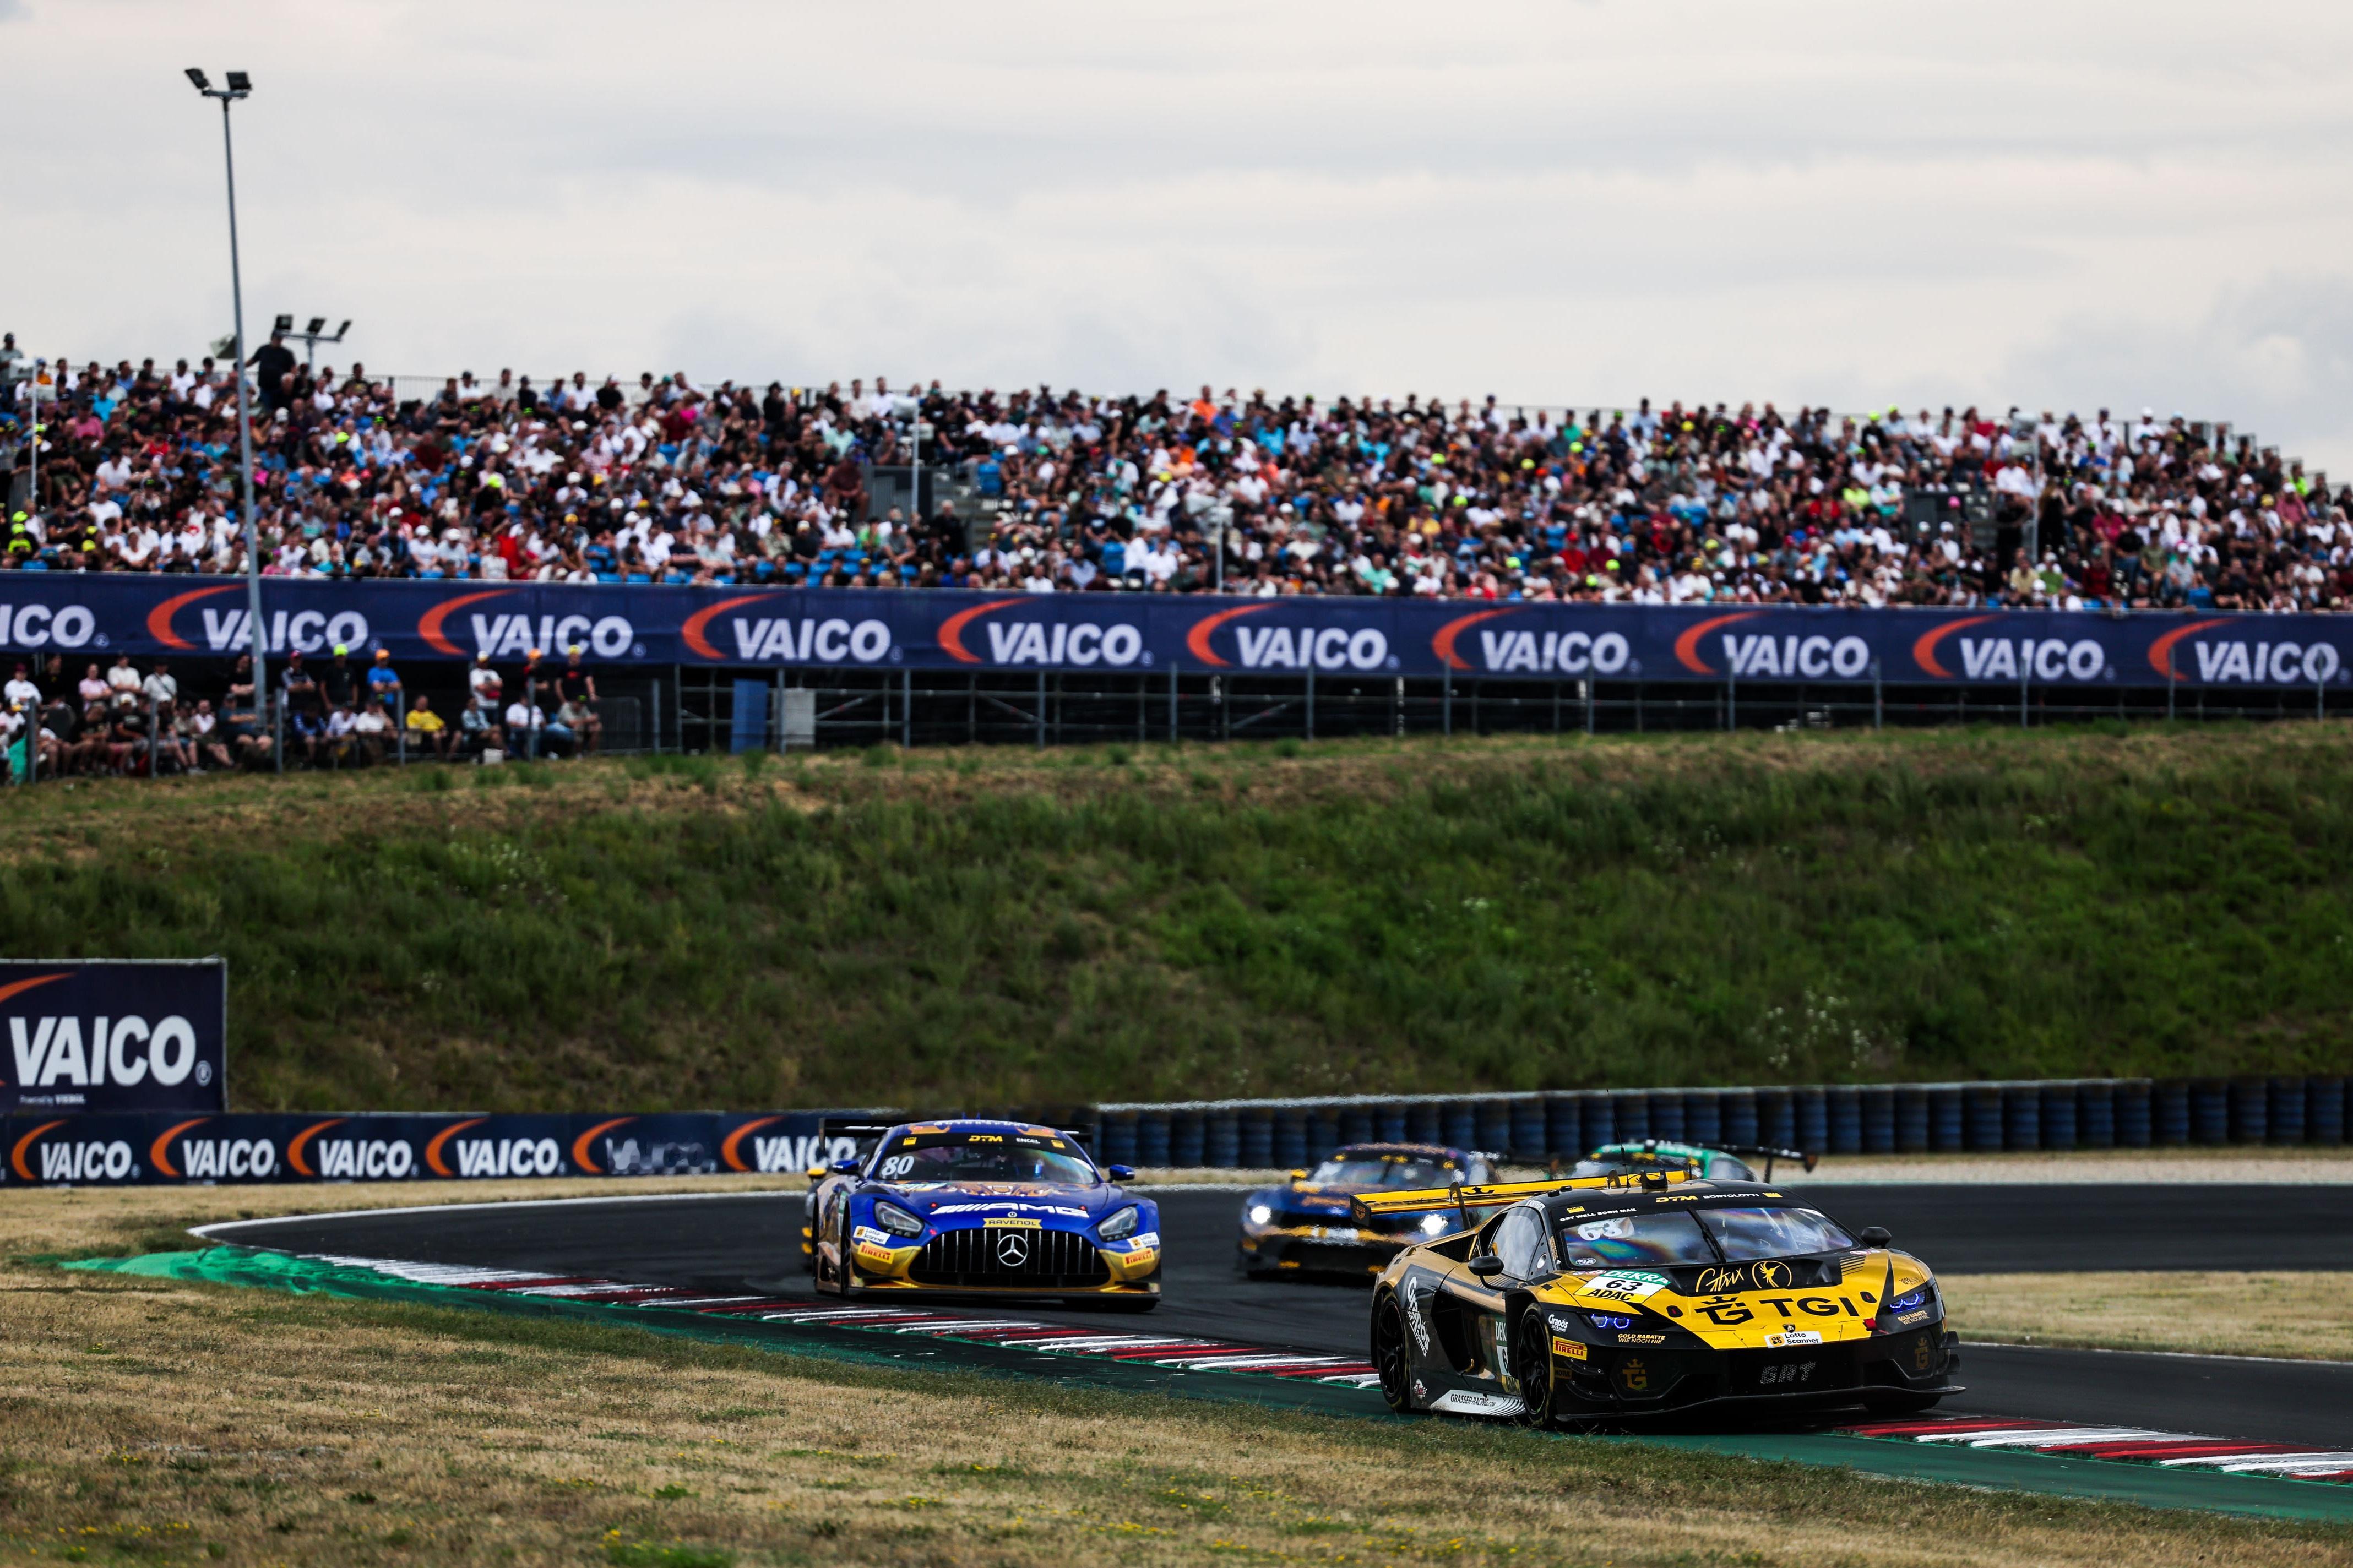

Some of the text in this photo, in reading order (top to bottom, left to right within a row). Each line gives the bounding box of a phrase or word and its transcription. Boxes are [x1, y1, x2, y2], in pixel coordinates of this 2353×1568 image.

[203, 608, 368, 652] VAICO
[471, 613, 634, 657] VAICO
[733, 618, 891, 661] VAICO
[987, 622, 1142, 665] VAICO
[1236, 626, 1388, 669] VAICO
[1481, 630, 1629, 673] VAICO
[1722, 634, 1869, 676] VAICO
[1960, 638, 2104, 679] VAICO
[2196, 641, 2339, 682] VAICO
[9, 1015, 196, 1087] VAICO
[41, 1140, 132, 1180] VAICO
[182, 1139, 275, 1177] VAICO
[319, 1139, 412, 1178] VAICO
[457, 1137, 559, 1177] VAICO
[754, 1135, 857, 1173] VAICO
[881, 1155, 915, 1177] 80
[983, 1202, 1090, 1218] AMG
[866, 1228, 881, 1236] Lotto
[861, 1245, 891, 1260] PIRELLI
[1586, 1288, 1635, 1302] ADAC
[1603, 1270, 1669, 1284] DEKRA
[1605, 1279, 1643, 1292] 63
[1406, 1306, 1416, 1326] SOFT
[1758, 1297, 1860, 1317] TGI
[1415, 1329, 1427, 1357] DRINKS
[1555, 1340, 1584, 1357] PIRELLI
